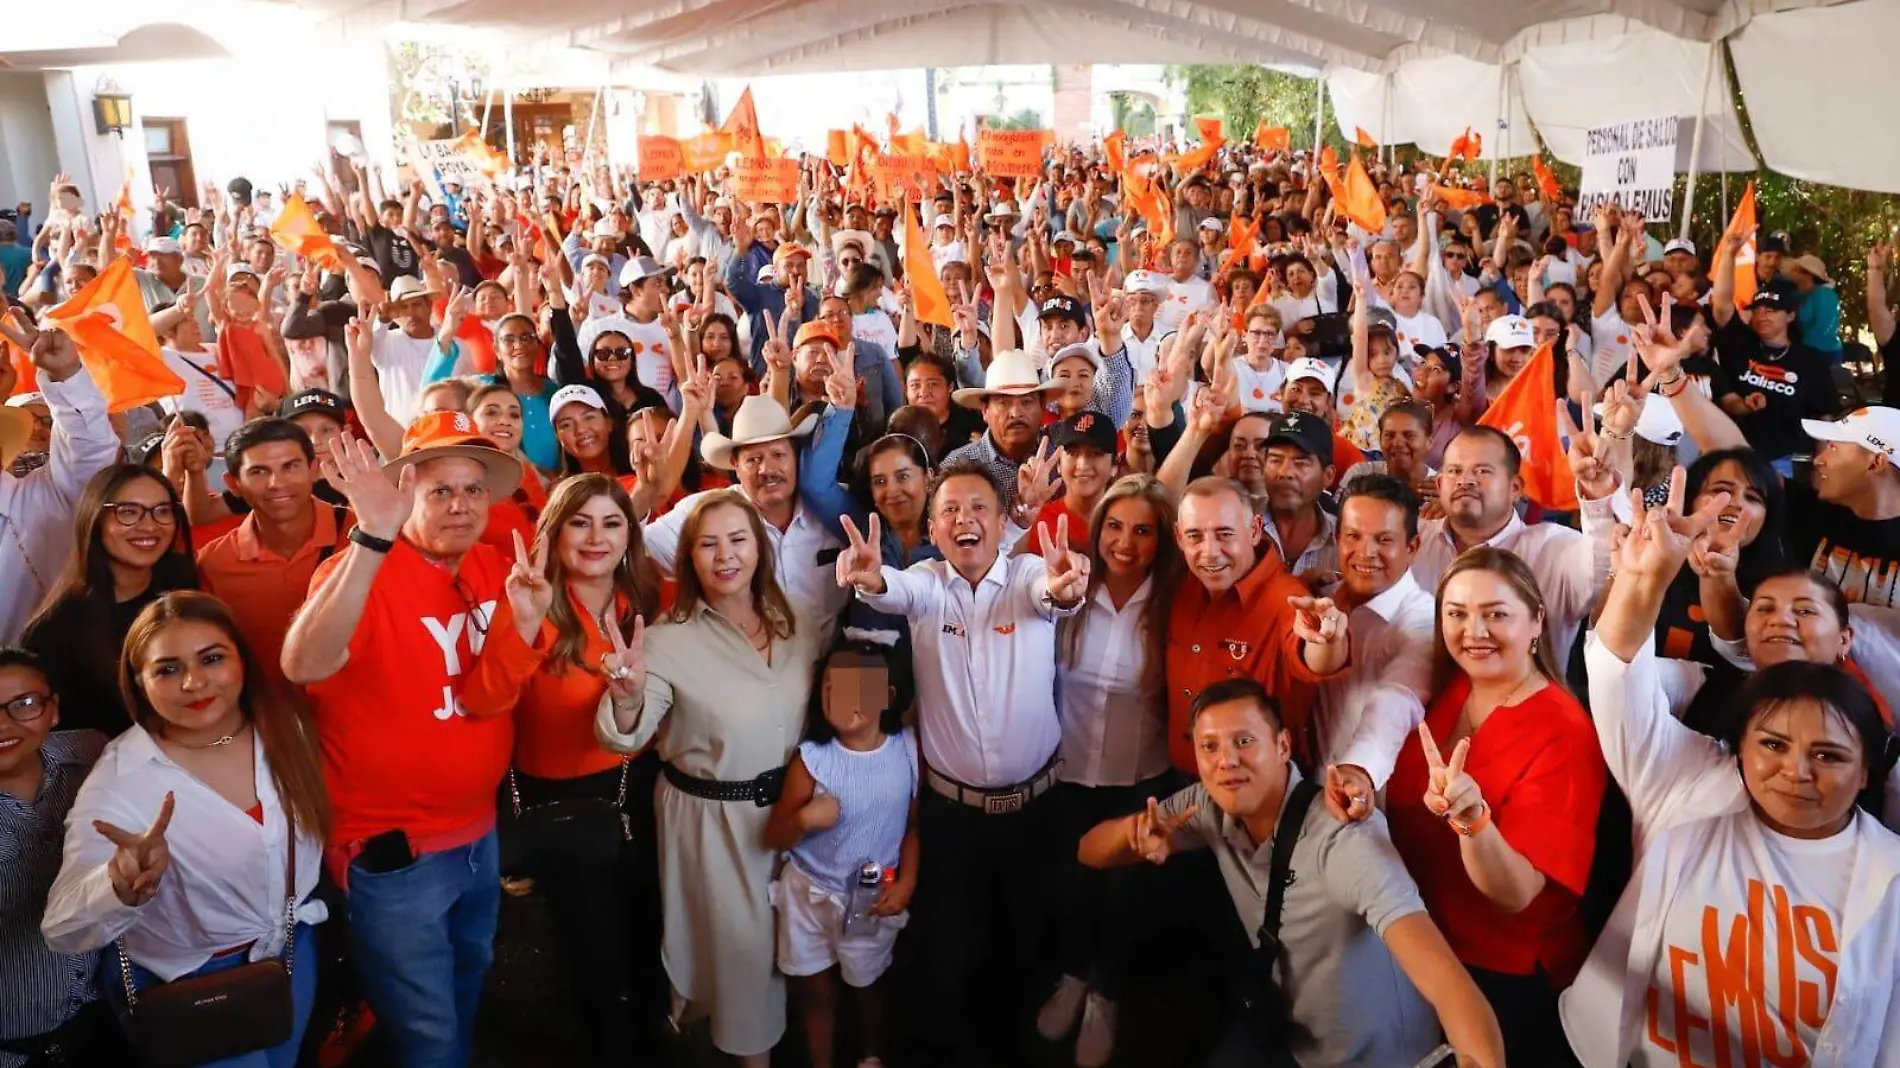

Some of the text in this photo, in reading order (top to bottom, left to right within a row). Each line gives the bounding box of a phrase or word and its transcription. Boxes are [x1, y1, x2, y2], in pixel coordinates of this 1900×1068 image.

[1587, 115, 1678, 155] PERSONAL DE SALUD
[1617, 156, 1637, 185] CON
[1738, 369, 1796, 396] Jalisco
[1646, 877, 1839, 1068] LEMUS
